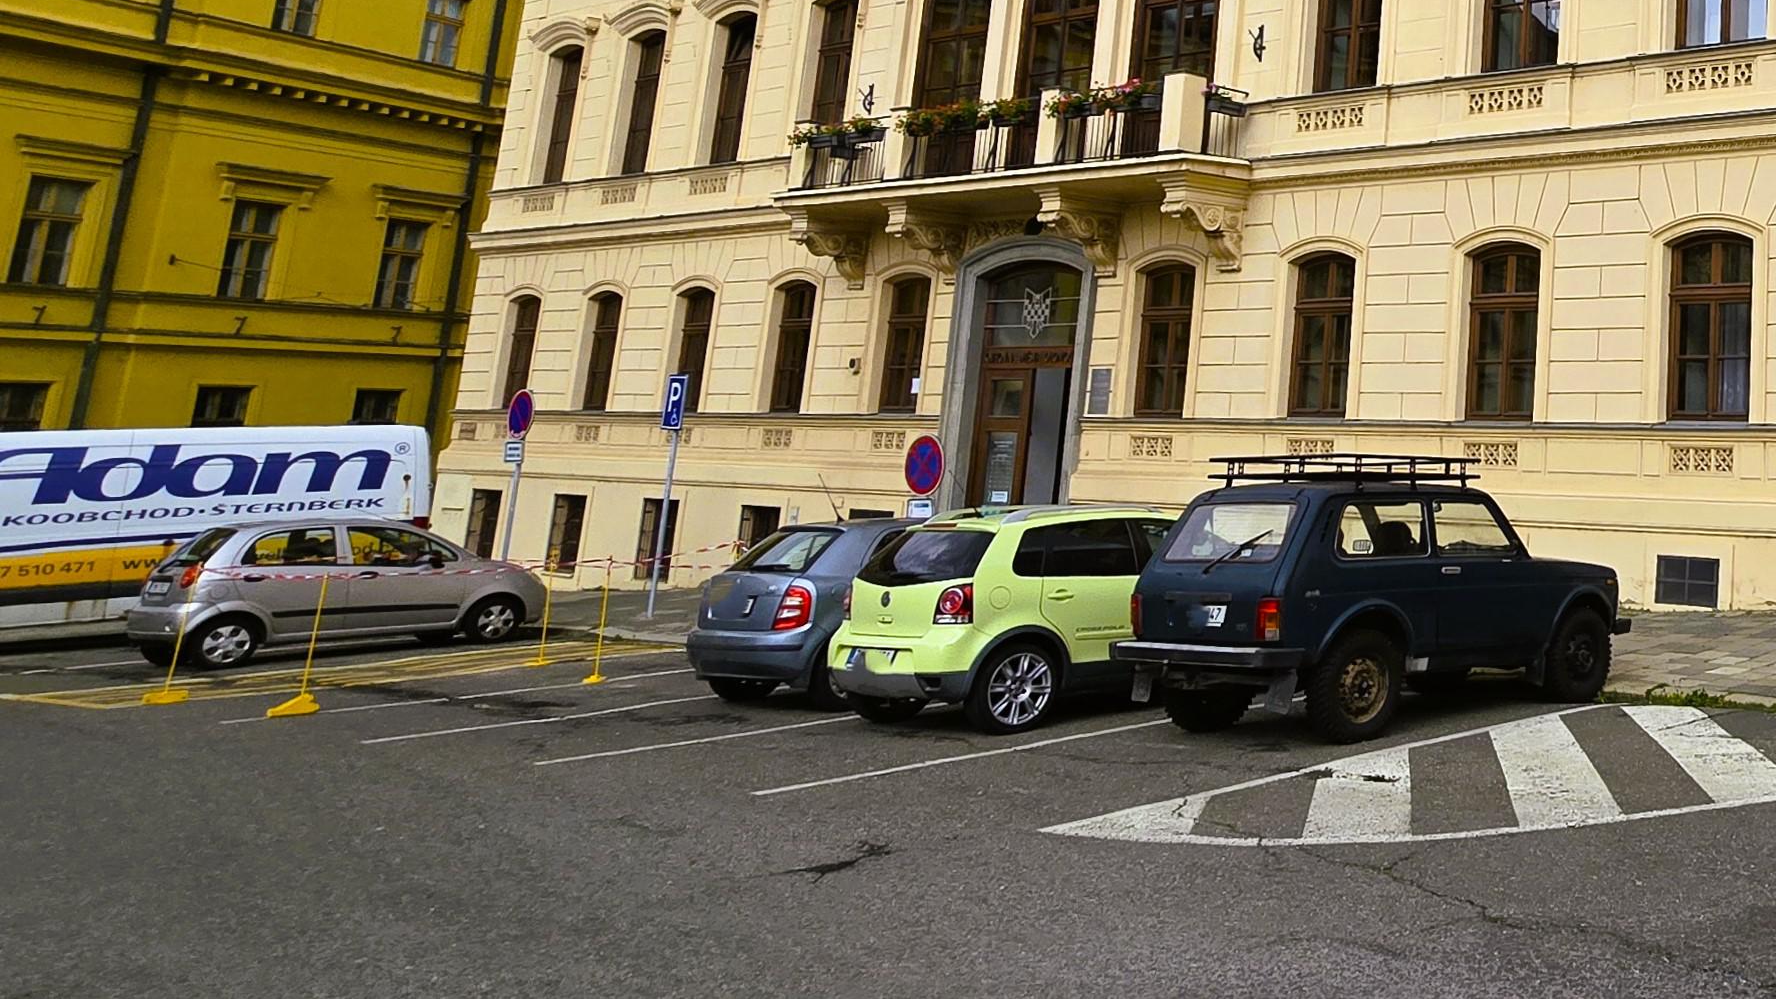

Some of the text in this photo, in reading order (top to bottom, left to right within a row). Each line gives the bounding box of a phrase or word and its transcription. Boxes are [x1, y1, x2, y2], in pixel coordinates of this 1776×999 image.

[668, 382, 681, 412] P
[18, 563, 55, 577] 510
[60, 561, 96, 574] 471
